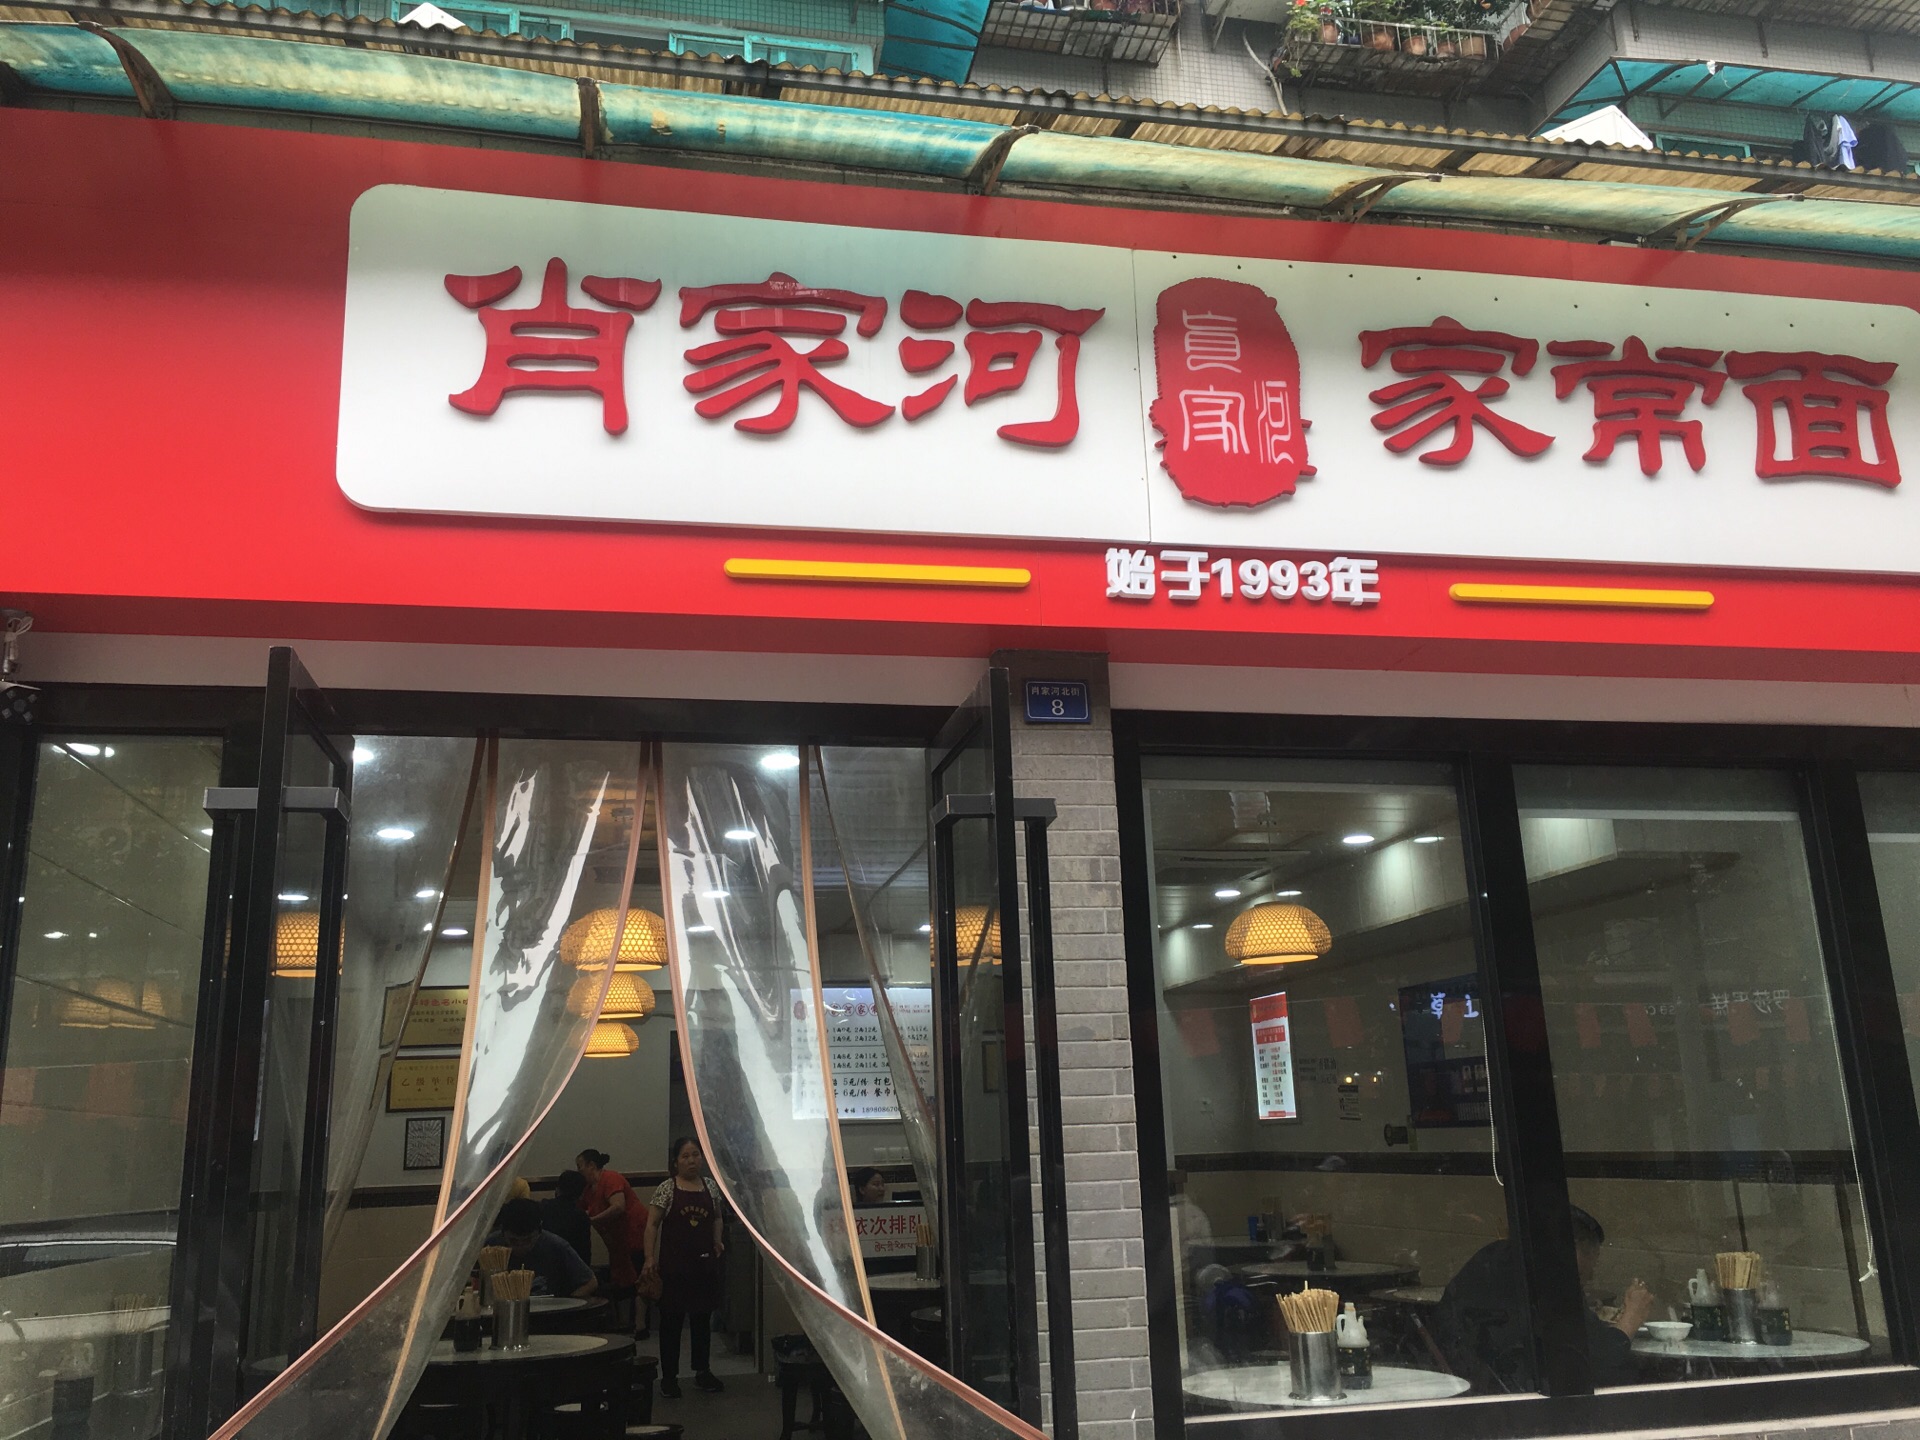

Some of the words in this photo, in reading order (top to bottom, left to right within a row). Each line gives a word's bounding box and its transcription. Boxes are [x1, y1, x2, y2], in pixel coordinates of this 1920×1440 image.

[444, 257, 1106, 447] 肖家河
[1358, 316, 1902, 488] 家常面
[1105, 547, 1381, 606] 始于1993年
[1031, 686, 1080, 696] 肖家河北街
[1051, 699, 1065, 716] 8
